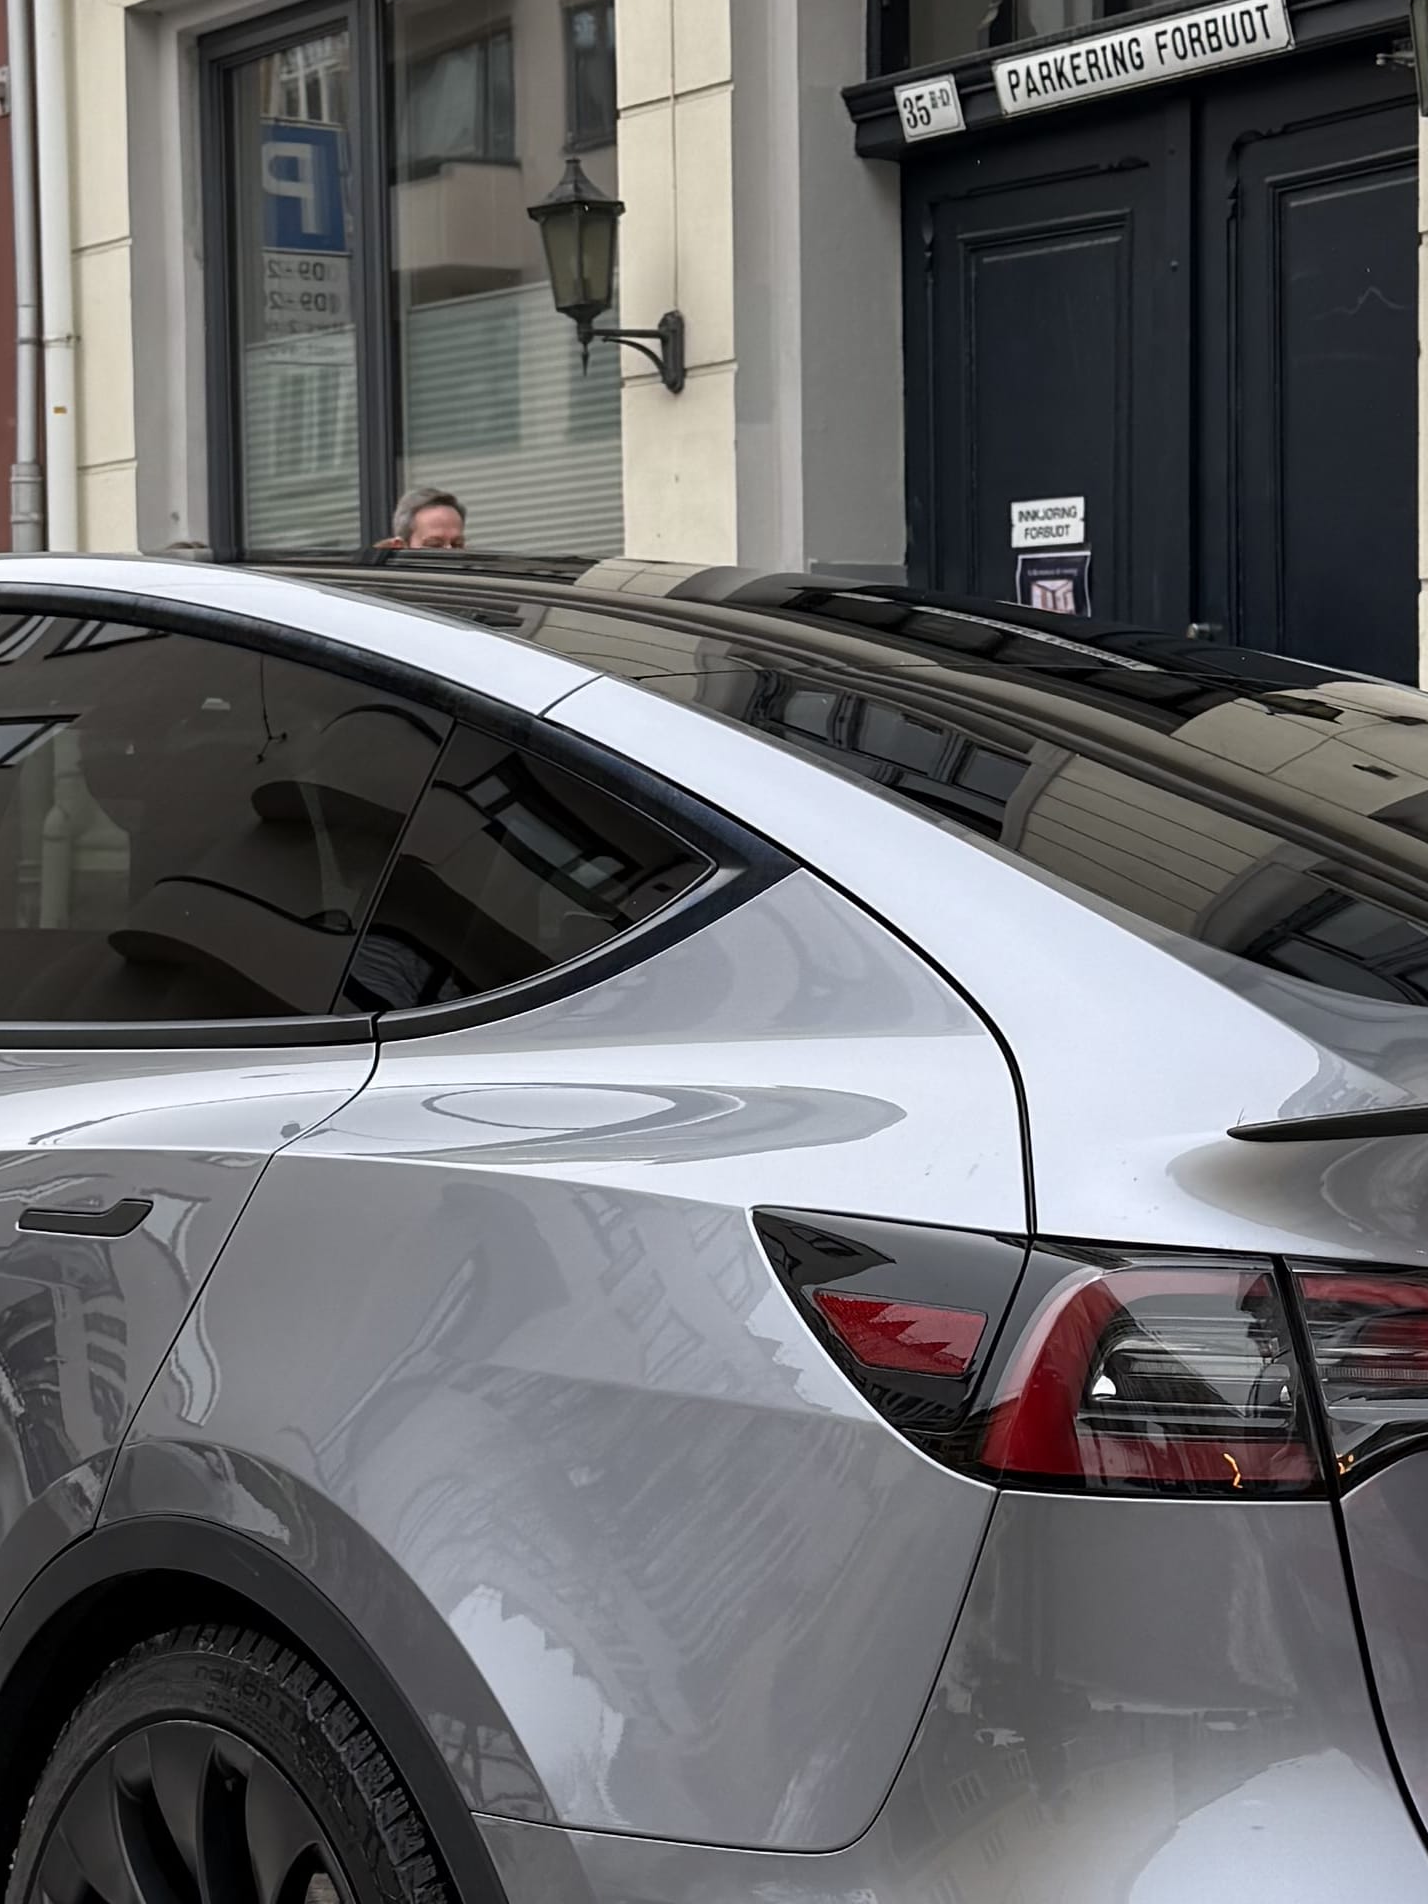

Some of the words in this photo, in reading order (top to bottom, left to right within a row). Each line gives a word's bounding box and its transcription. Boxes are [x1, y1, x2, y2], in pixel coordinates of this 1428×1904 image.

[1007, 36, 1145, 102] PARKERING
[1155, 3, 1274, 65] FORBUDT
[1024, 524, 1070, 540] FORBUDT
